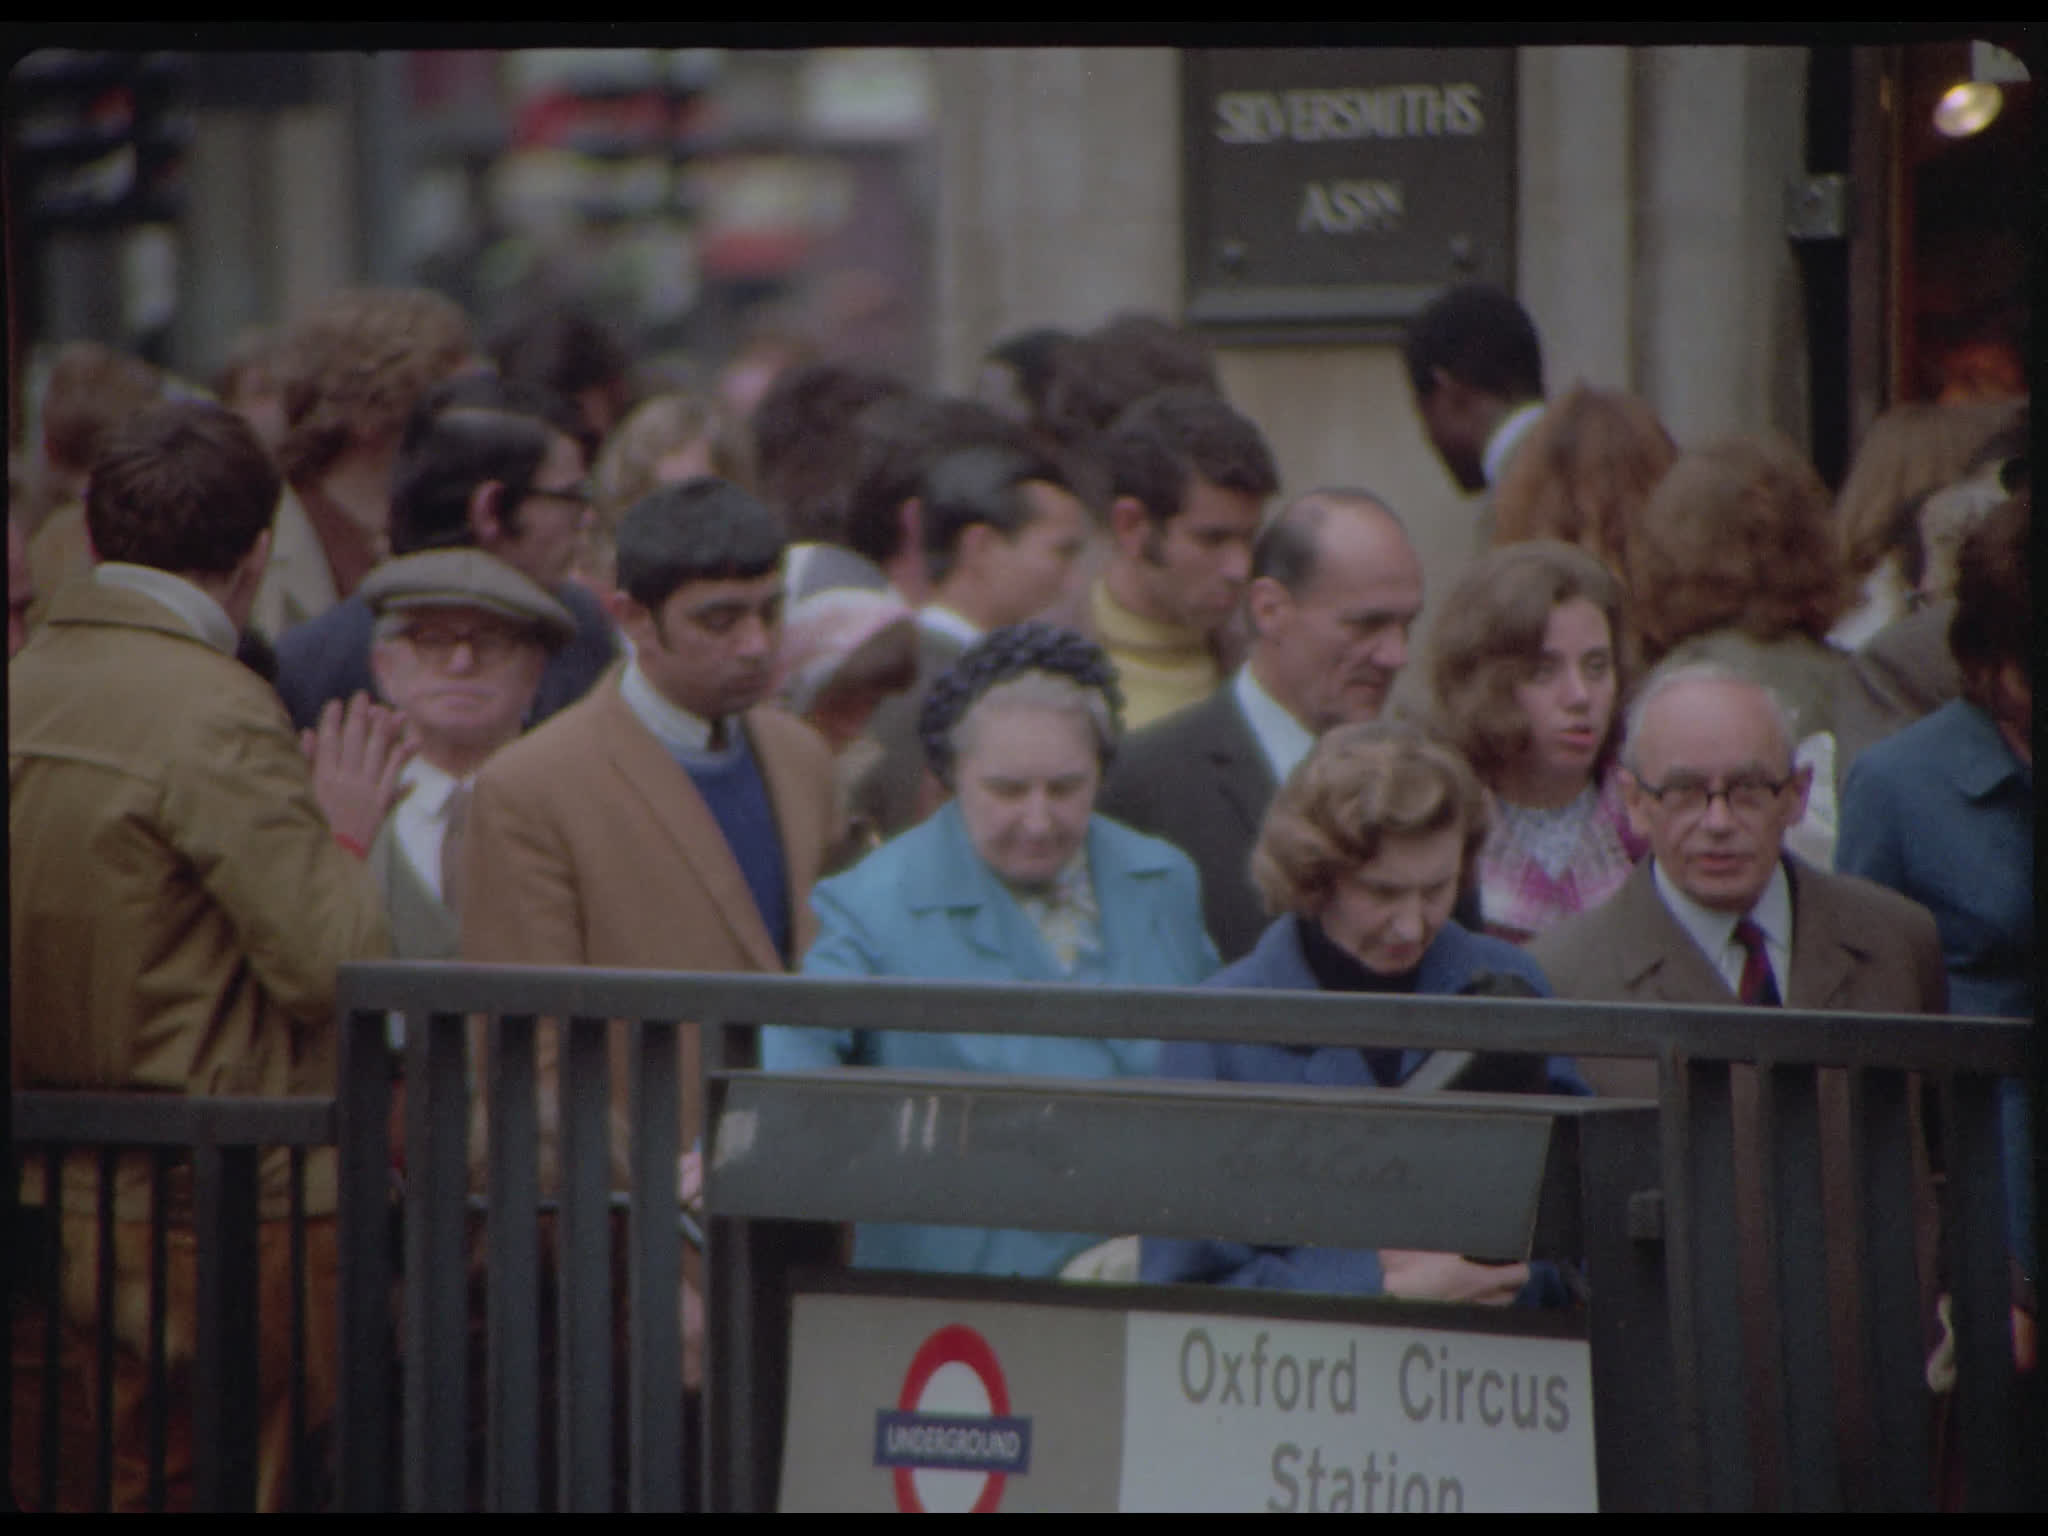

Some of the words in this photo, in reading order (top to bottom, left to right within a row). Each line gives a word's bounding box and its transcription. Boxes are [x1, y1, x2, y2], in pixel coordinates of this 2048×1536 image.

[1179, 1327, 1357, 1414] Oxford
[1399, 1341, 1571, 1432] Circus
[886, 1423, 1022, 1458] UNDERGROUND
[1266, 1441, 1465, 1513] Station
